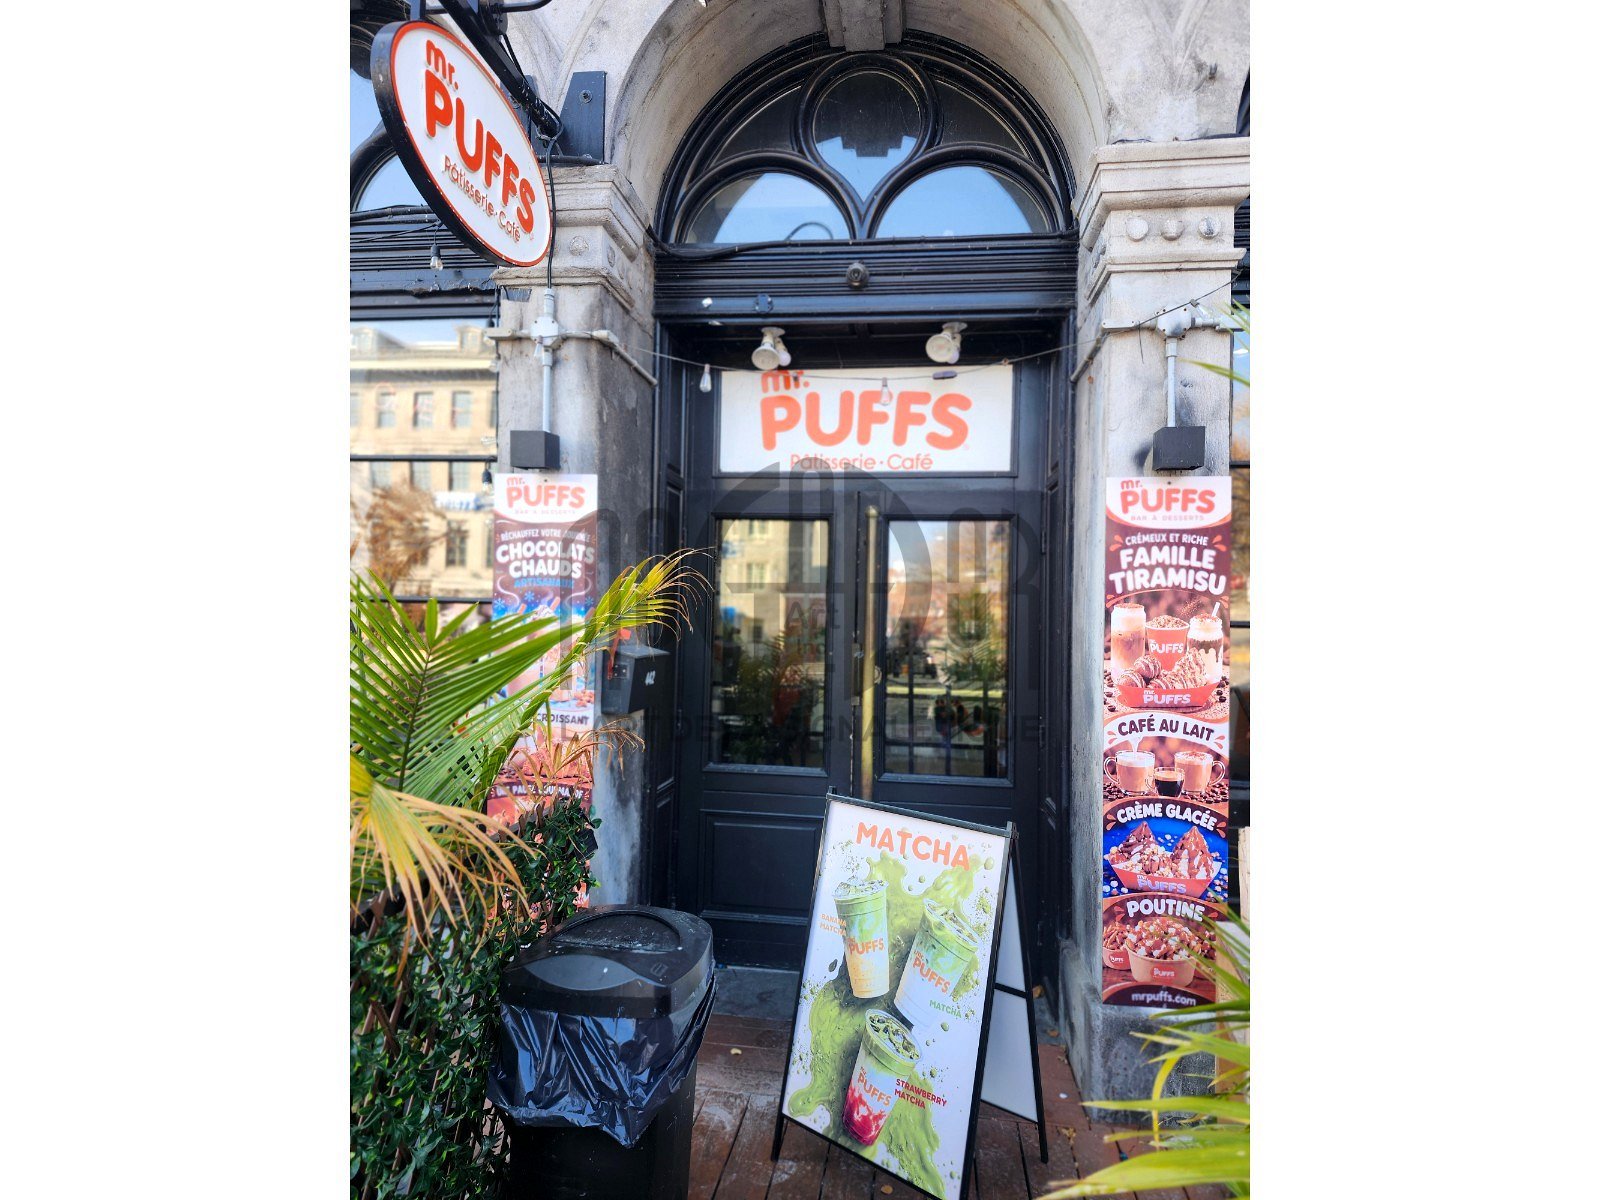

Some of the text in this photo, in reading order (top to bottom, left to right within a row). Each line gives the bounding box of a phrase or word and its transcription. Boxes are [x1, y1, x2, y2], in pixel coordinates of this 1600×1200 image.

[425, 40, 459, 90] mr.
[425, 69, 536, 233] PUFFS
[499, 210, 521, 242] Café
[761, 370, 810, 393] mr.
[760, 390, 972, 450] PUFFS
[790, 453, 934, 471] Pâtisserie Café
[506, 485, 586, 509] PUFFS
[1120, 480, 1143, 490] mr.
[1120, 489, 1216, 514] PUFFS
[1125, 532, 1209, 546] CRÉMEUX ET RICHE
[496, 541, 595, 565] CHOCOLATS
[1120, 545, 1217, 570] FAMILLE
[509, 559, 582, 579] CHAUDS
[1109, 567, 1227, 596] TIRAMISU
[1149, 643, 1185, 654] PUFFS
[1143, 694, 1191, 704] PUFFS
[1117, 713, 1215, 741] CAFÉ AU LAIT
[1116, 800, 1218, 831] CRÈME GLACÉE
[855, 821, 971, 871] MATCHA
[1137, 879, 1187, 894] PUFFS
[821, 913, 847, 927] BANANA
[1126, 898, 1206, 922] POUTINE
[820, 922, 847, 937] MATCHA
[848, 937, 885, 956] PUFFS
[912, 956, 951, 994] PUFFS
[929, 999, 962, 1018] MATCHA
[1131, 991, 1197, 1006] mrpuffs.com
[857, 1071, 892, 1107] PUFFS
[894, 1088, 926, 1110] MATCHA
[895, 1078, 948, 1107] STRAWBERRY
